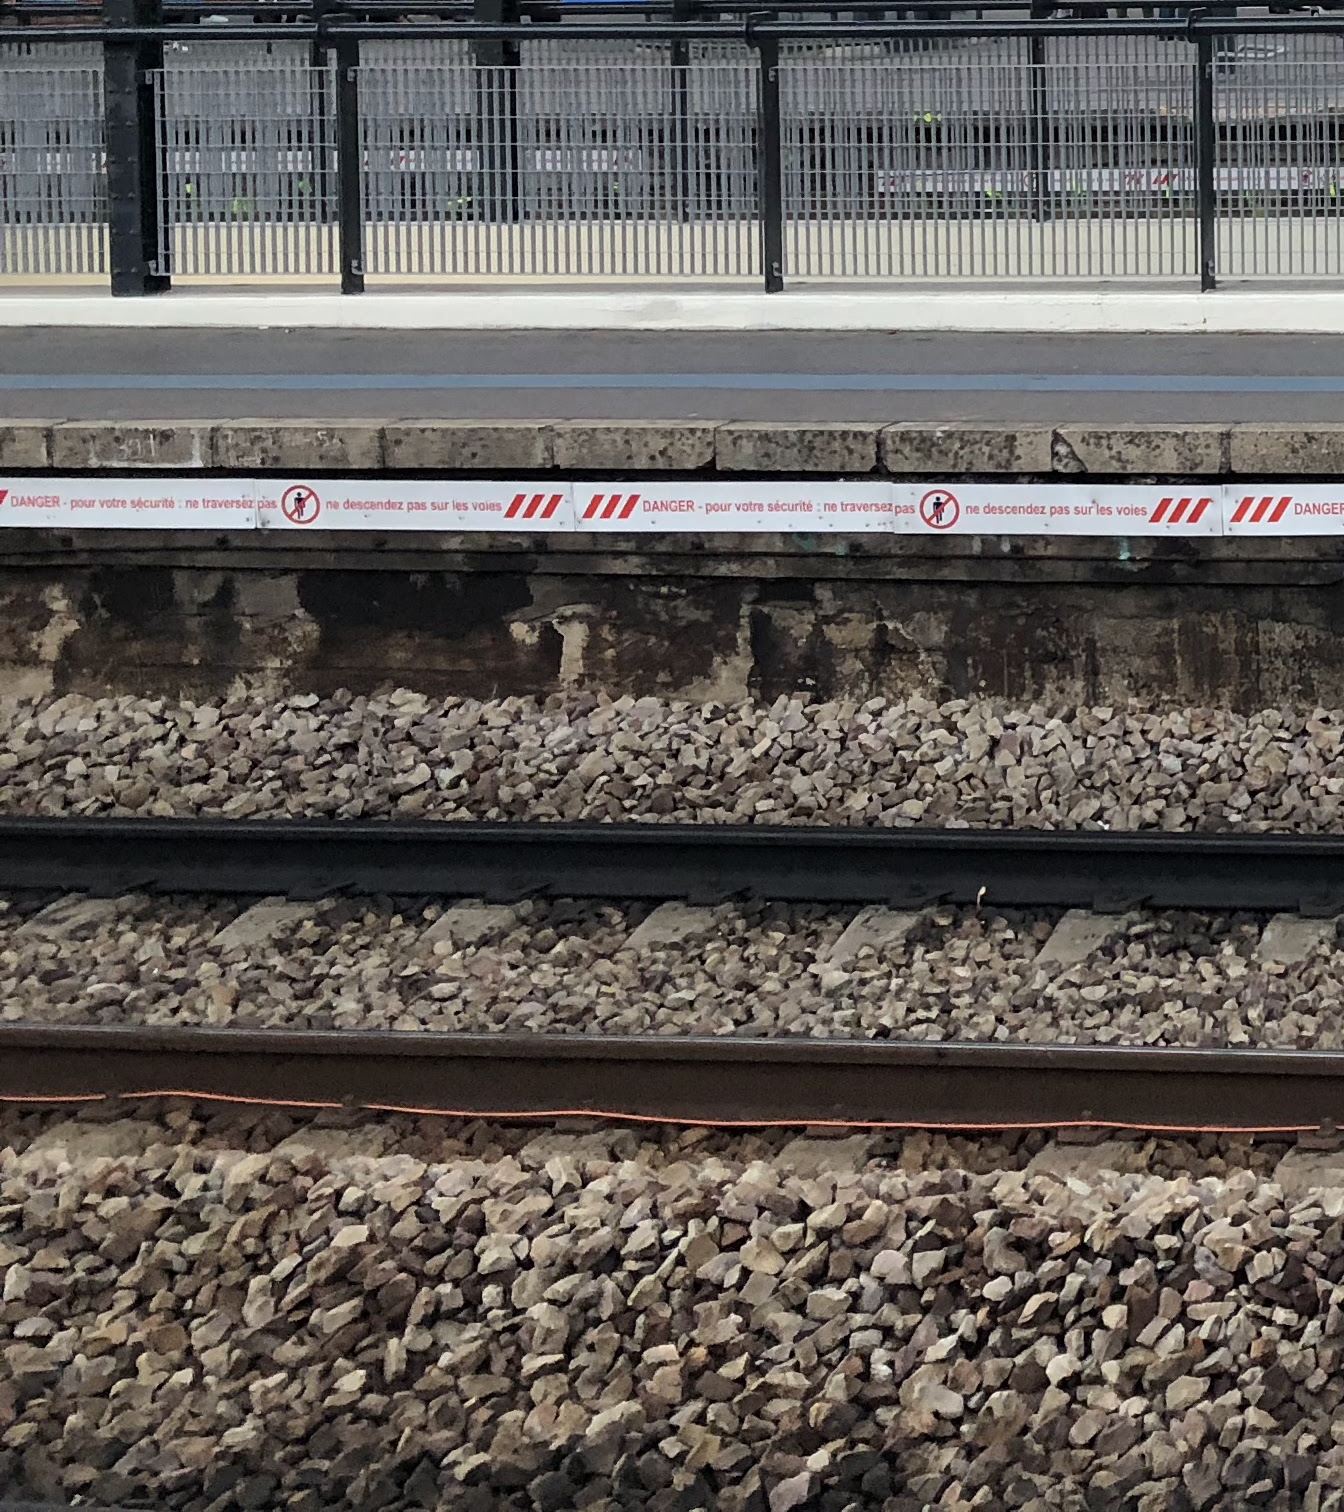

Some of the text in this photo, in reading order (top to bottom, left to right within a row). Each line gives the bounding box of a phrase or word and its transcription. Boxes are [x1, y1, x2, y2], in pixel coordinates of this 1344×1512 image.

[11, 496, 60, 508] DANGER
[70, 499, 96, 510] pour
[99, 498, 127, 508] votre
[130, 497, 175, 508] sécurité
[185, 500, 199, 508] ne
[202, 498, 255, 509] traversez
[257, 500, 278, 512] pas
[326, 499, 502, 513] ne descendez pas sur les voies
[643, 500, 695, 512] DANGER
[705, 503, 732, 515] pour
[737, 501, 765, 512] votre
[767, 500, 813, 512] sécurité
[824, 503, 837, 512] ne
[840, 502, 893, 512] traversez
[895, 505, 915, 516] pas
[966, 503, 1147, 517] ne descendez pas sur les voies
